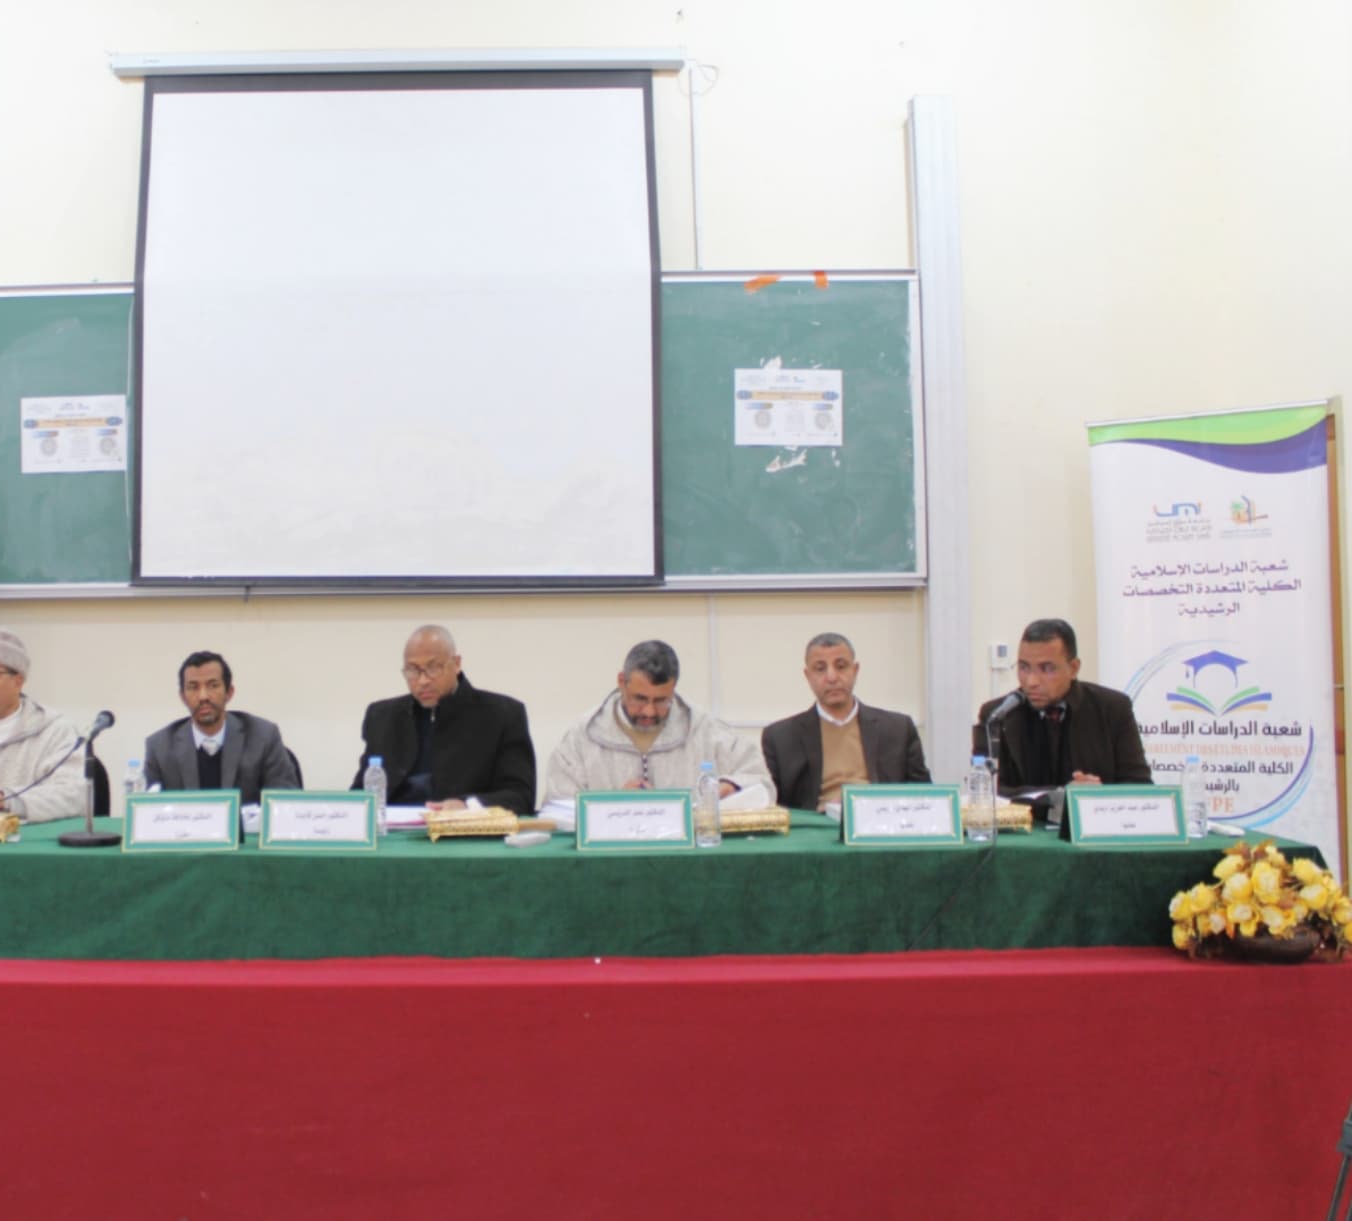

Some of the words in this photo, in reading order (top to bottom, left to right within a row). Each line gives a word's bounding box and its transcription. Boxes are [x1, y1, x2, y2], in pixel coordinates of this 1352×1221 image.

[1192, 561, 1248, 577] الدراسات
[1250, 558, 1289, 576] شعبة
[1122, 583, 1194, 597] التخصصات
[1196, 581, 1246, 595] المتعددة
[1248, 578, 1301, 596] الكلية
[1178, 602, 1240, 617] الرشيدية
[1198, 719, 1258, 739] الدراسات
[1261, 720, 1302, 737] شعبة
[1200, 759, 1255, 774] المتعددة
[1258, 760, 1293, 776] الكلية
